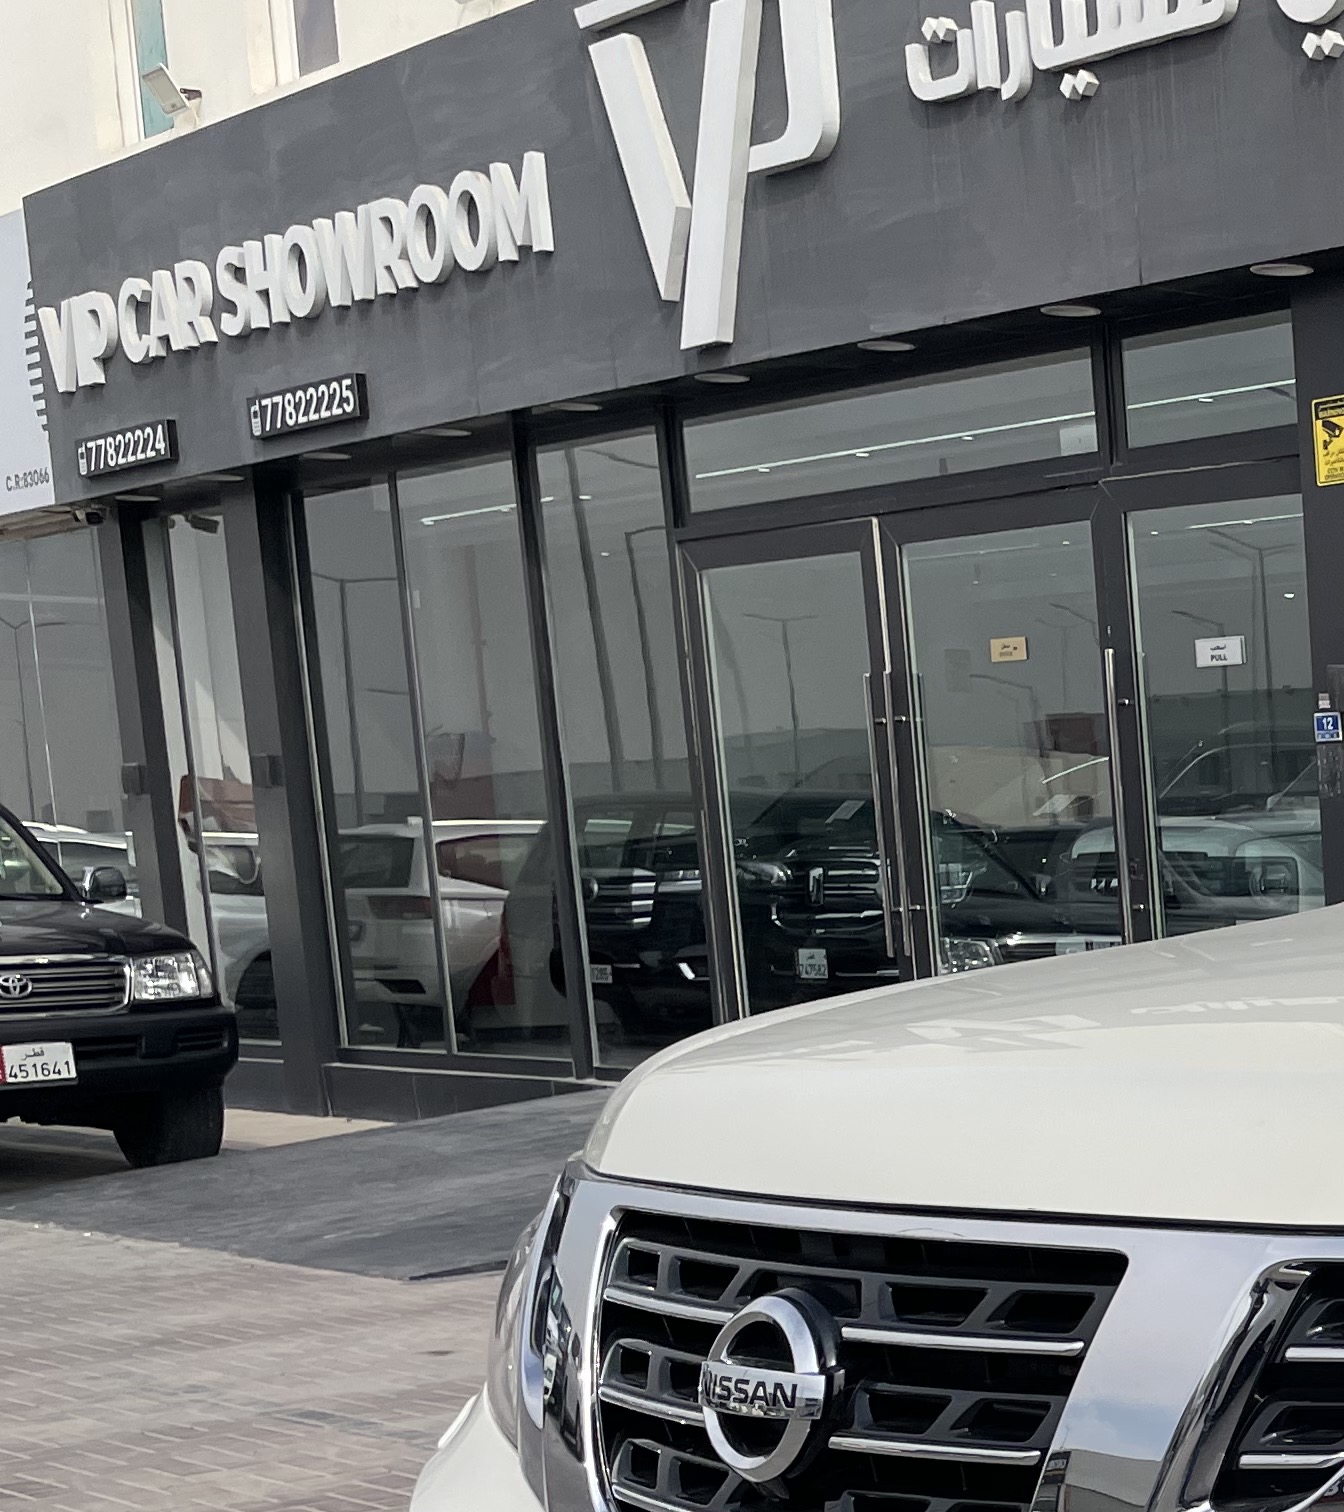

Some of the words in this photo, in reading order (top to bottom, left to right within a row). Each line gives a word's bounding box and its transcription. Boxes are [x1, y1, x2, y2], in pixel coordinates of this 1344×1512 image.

[118, 260, 219, 363] CAR
[216, 151, 554, 338] SHOWROOM
[261, 378, 355, 431] 77822225
[87, 424, 166, 472] 77822224
[1322, 717, 1334, 730] 12
[9, 1060, 71, 1080] 451641
[21, 1047, 45, 1061] قطر
[703, 1370, 798, 1409] NISSAN
